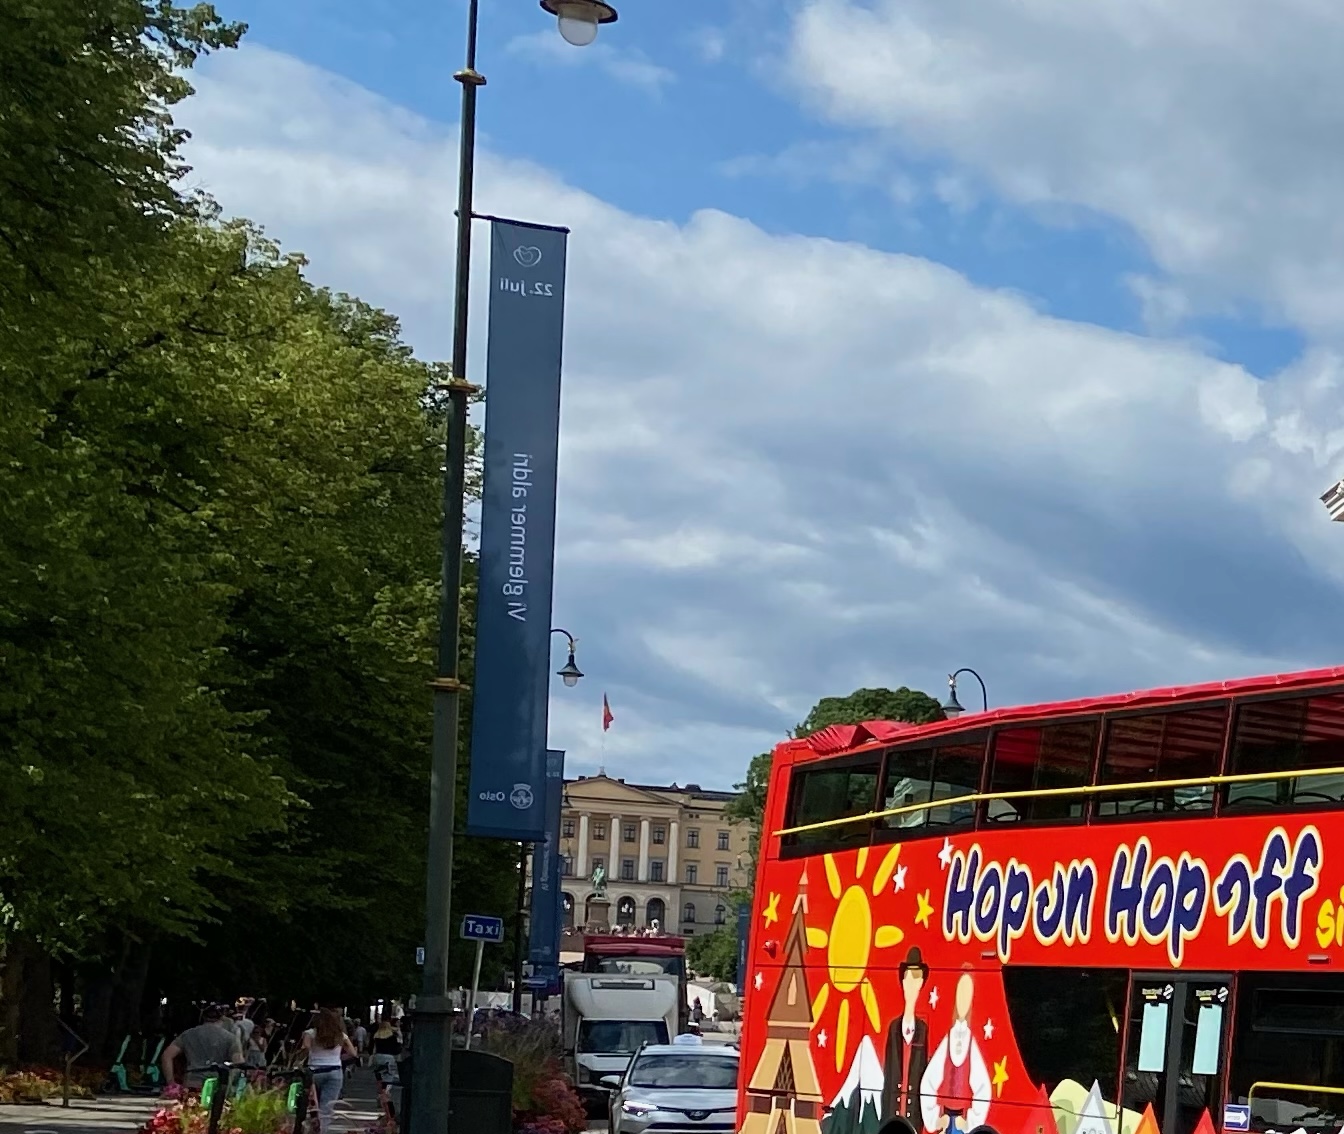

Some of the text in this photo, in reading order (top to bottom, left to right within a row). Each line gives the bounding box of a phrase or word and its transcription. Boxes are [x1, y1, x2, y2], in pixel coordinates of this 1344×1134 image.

[467, 920, 500, 936] Taxi
[943, 843, 1032, 964] Hop
[1032, 858, 1097, 947] on
[1105, 836, 1209, 968] Hop
[1212, 825, 1323, 949] off
